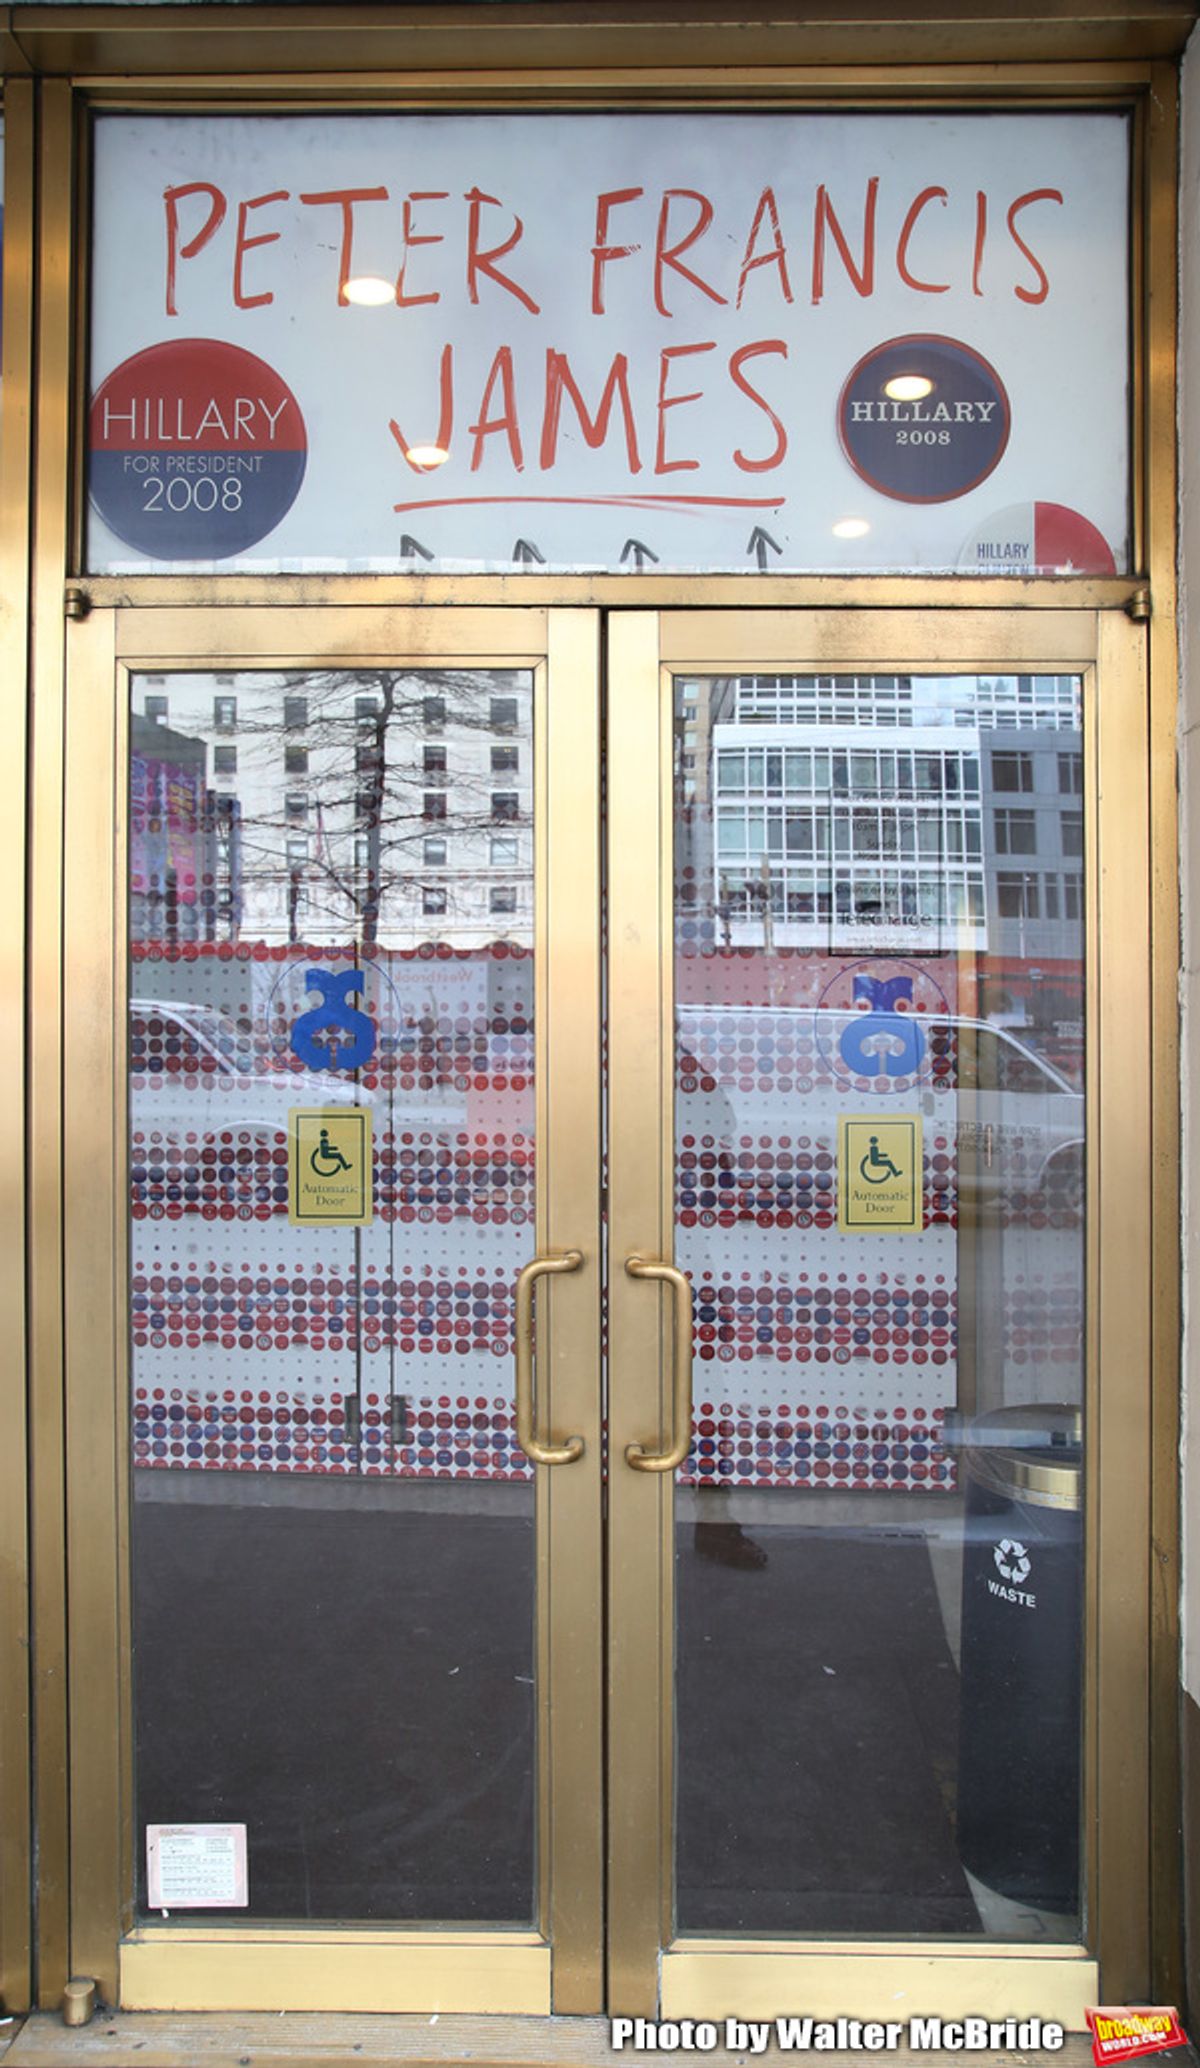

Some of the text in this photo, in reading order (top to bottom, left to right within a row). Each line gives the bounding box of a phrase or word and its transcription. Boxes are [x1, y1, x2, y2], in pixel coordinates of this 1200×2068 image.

[163, 175, 1064, 318] PETER FRANCIS
[388, 339, 789, 475] JAMES
[850, 401, 997, 423] HILLARY
[103, 397, 289, 441] HILLARY
[895, 429, 952, 446] 2008
[122, 455, 264, 474] FOR PRESIDENT
[141, 476, 243, 513] 2008
[976, 542, 1030, 560] HILLARY
[301, 1182, 359, 1195] Automatic
[851, 1189, 910, 1202] Automatic
[315, 1195, 347, 1208] Door
[864, 1202, 896, 1214] Door
[986, 1579, 1037, 1609] WASTE
